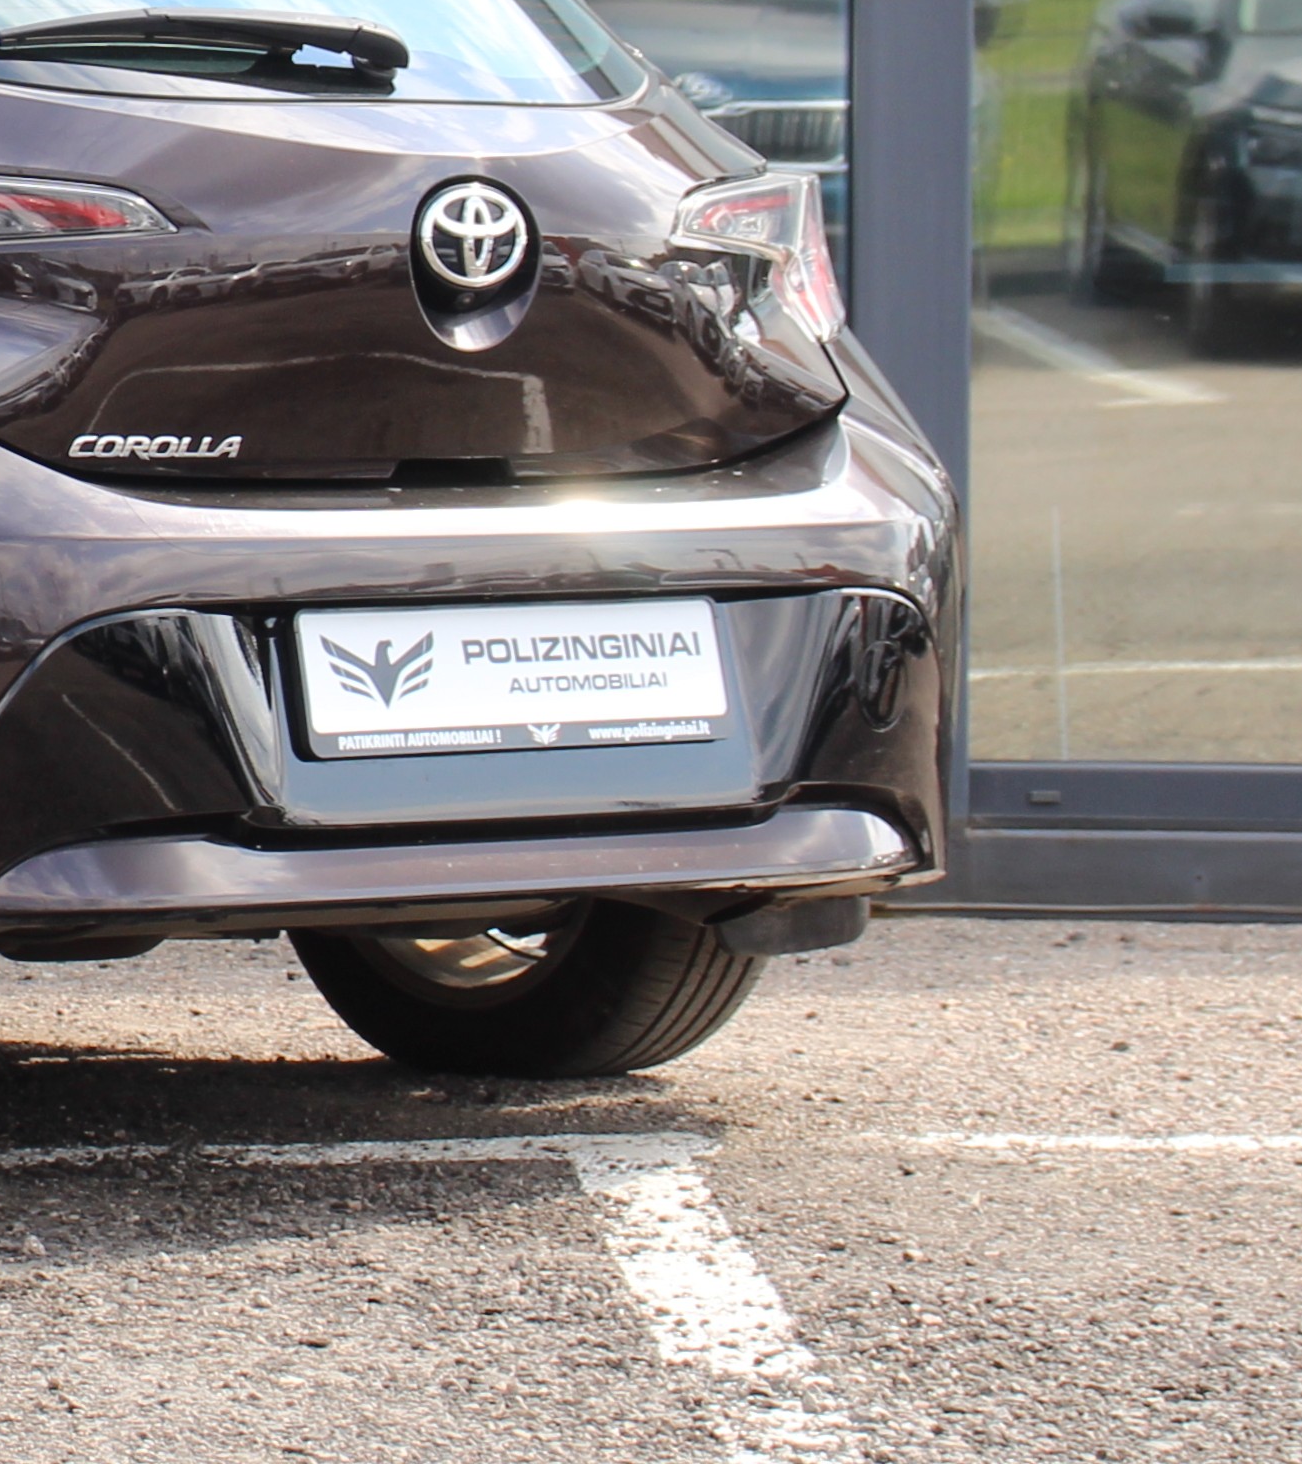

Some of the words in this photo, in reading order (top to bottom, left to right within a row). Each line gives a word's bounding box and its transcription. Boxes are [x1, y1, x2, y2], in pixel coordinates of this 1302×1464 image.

[68, 435, 243, 461] COROLLA
[461, 631, 702, 665] POLIZINGINIAI
[508, 672, 669, 694] AUTOMOBILIAI
[338, 732, 406, 751] PATIKRINTI
[407, 729, 494, 747] AUTOMOBILIAI
[588, 719, 711, 742] www.polizinginiai.lt
